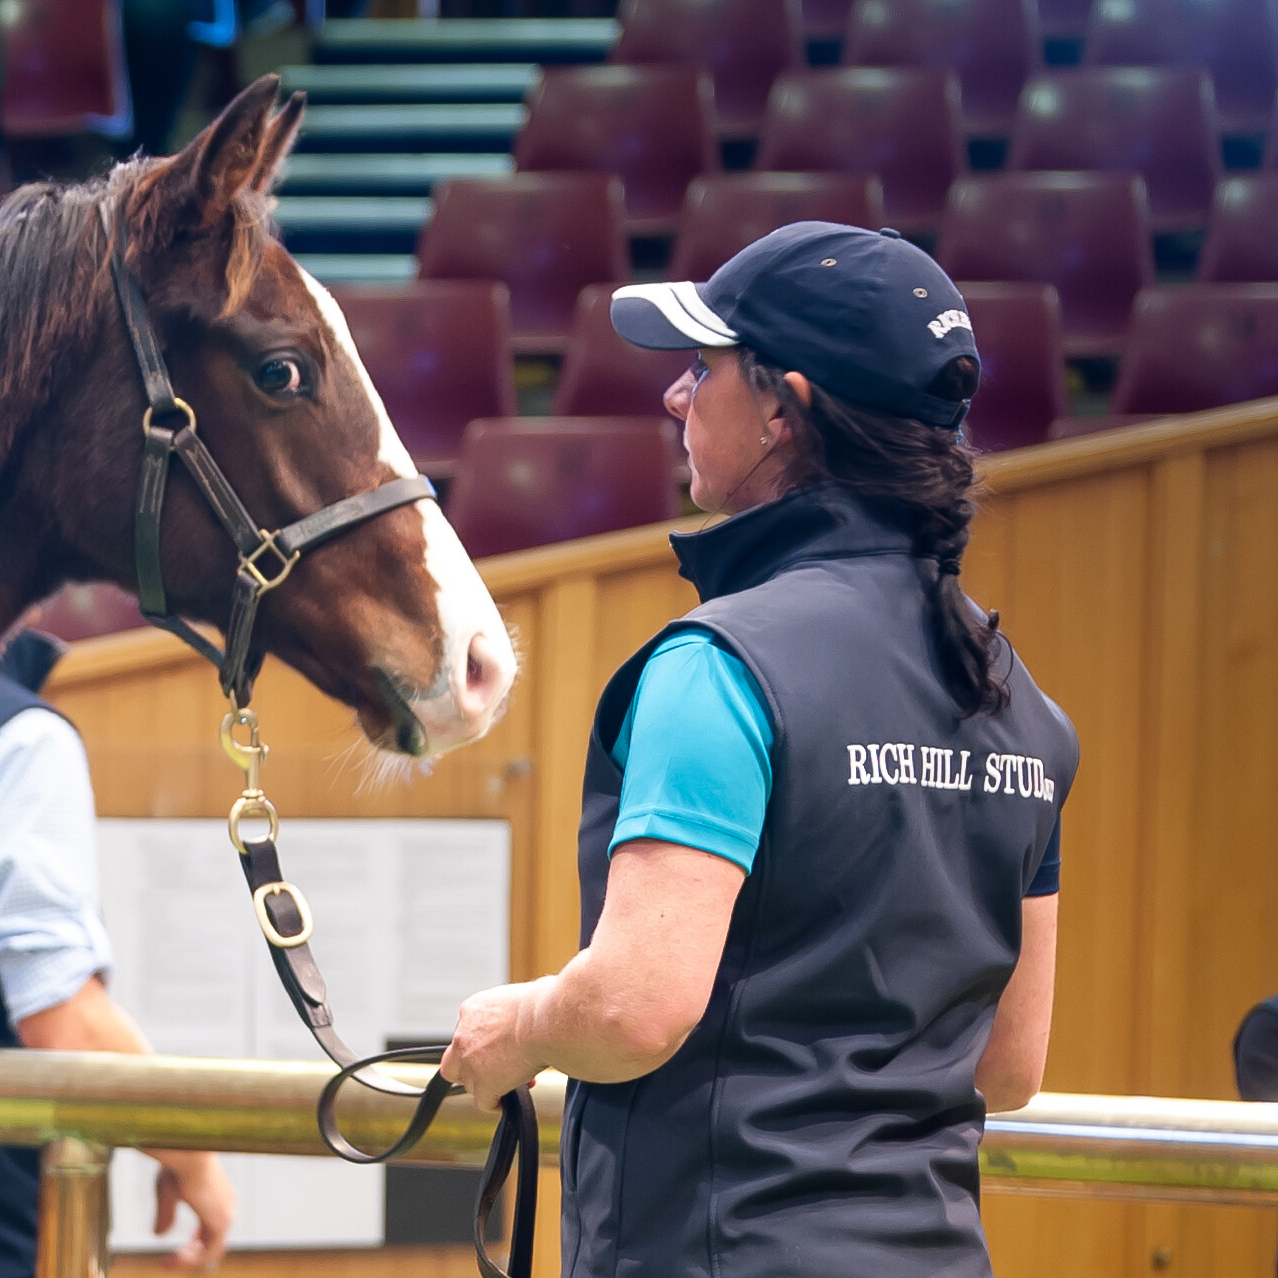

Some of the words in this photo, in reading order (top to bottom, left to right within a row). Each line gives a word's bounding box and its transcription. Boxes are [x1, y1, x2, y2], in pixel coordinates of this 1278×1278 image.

[846, 742, 918, 786] RICH
[920, 746, 974, 790] HILL
[983, 752, 1045, 799] STUD
